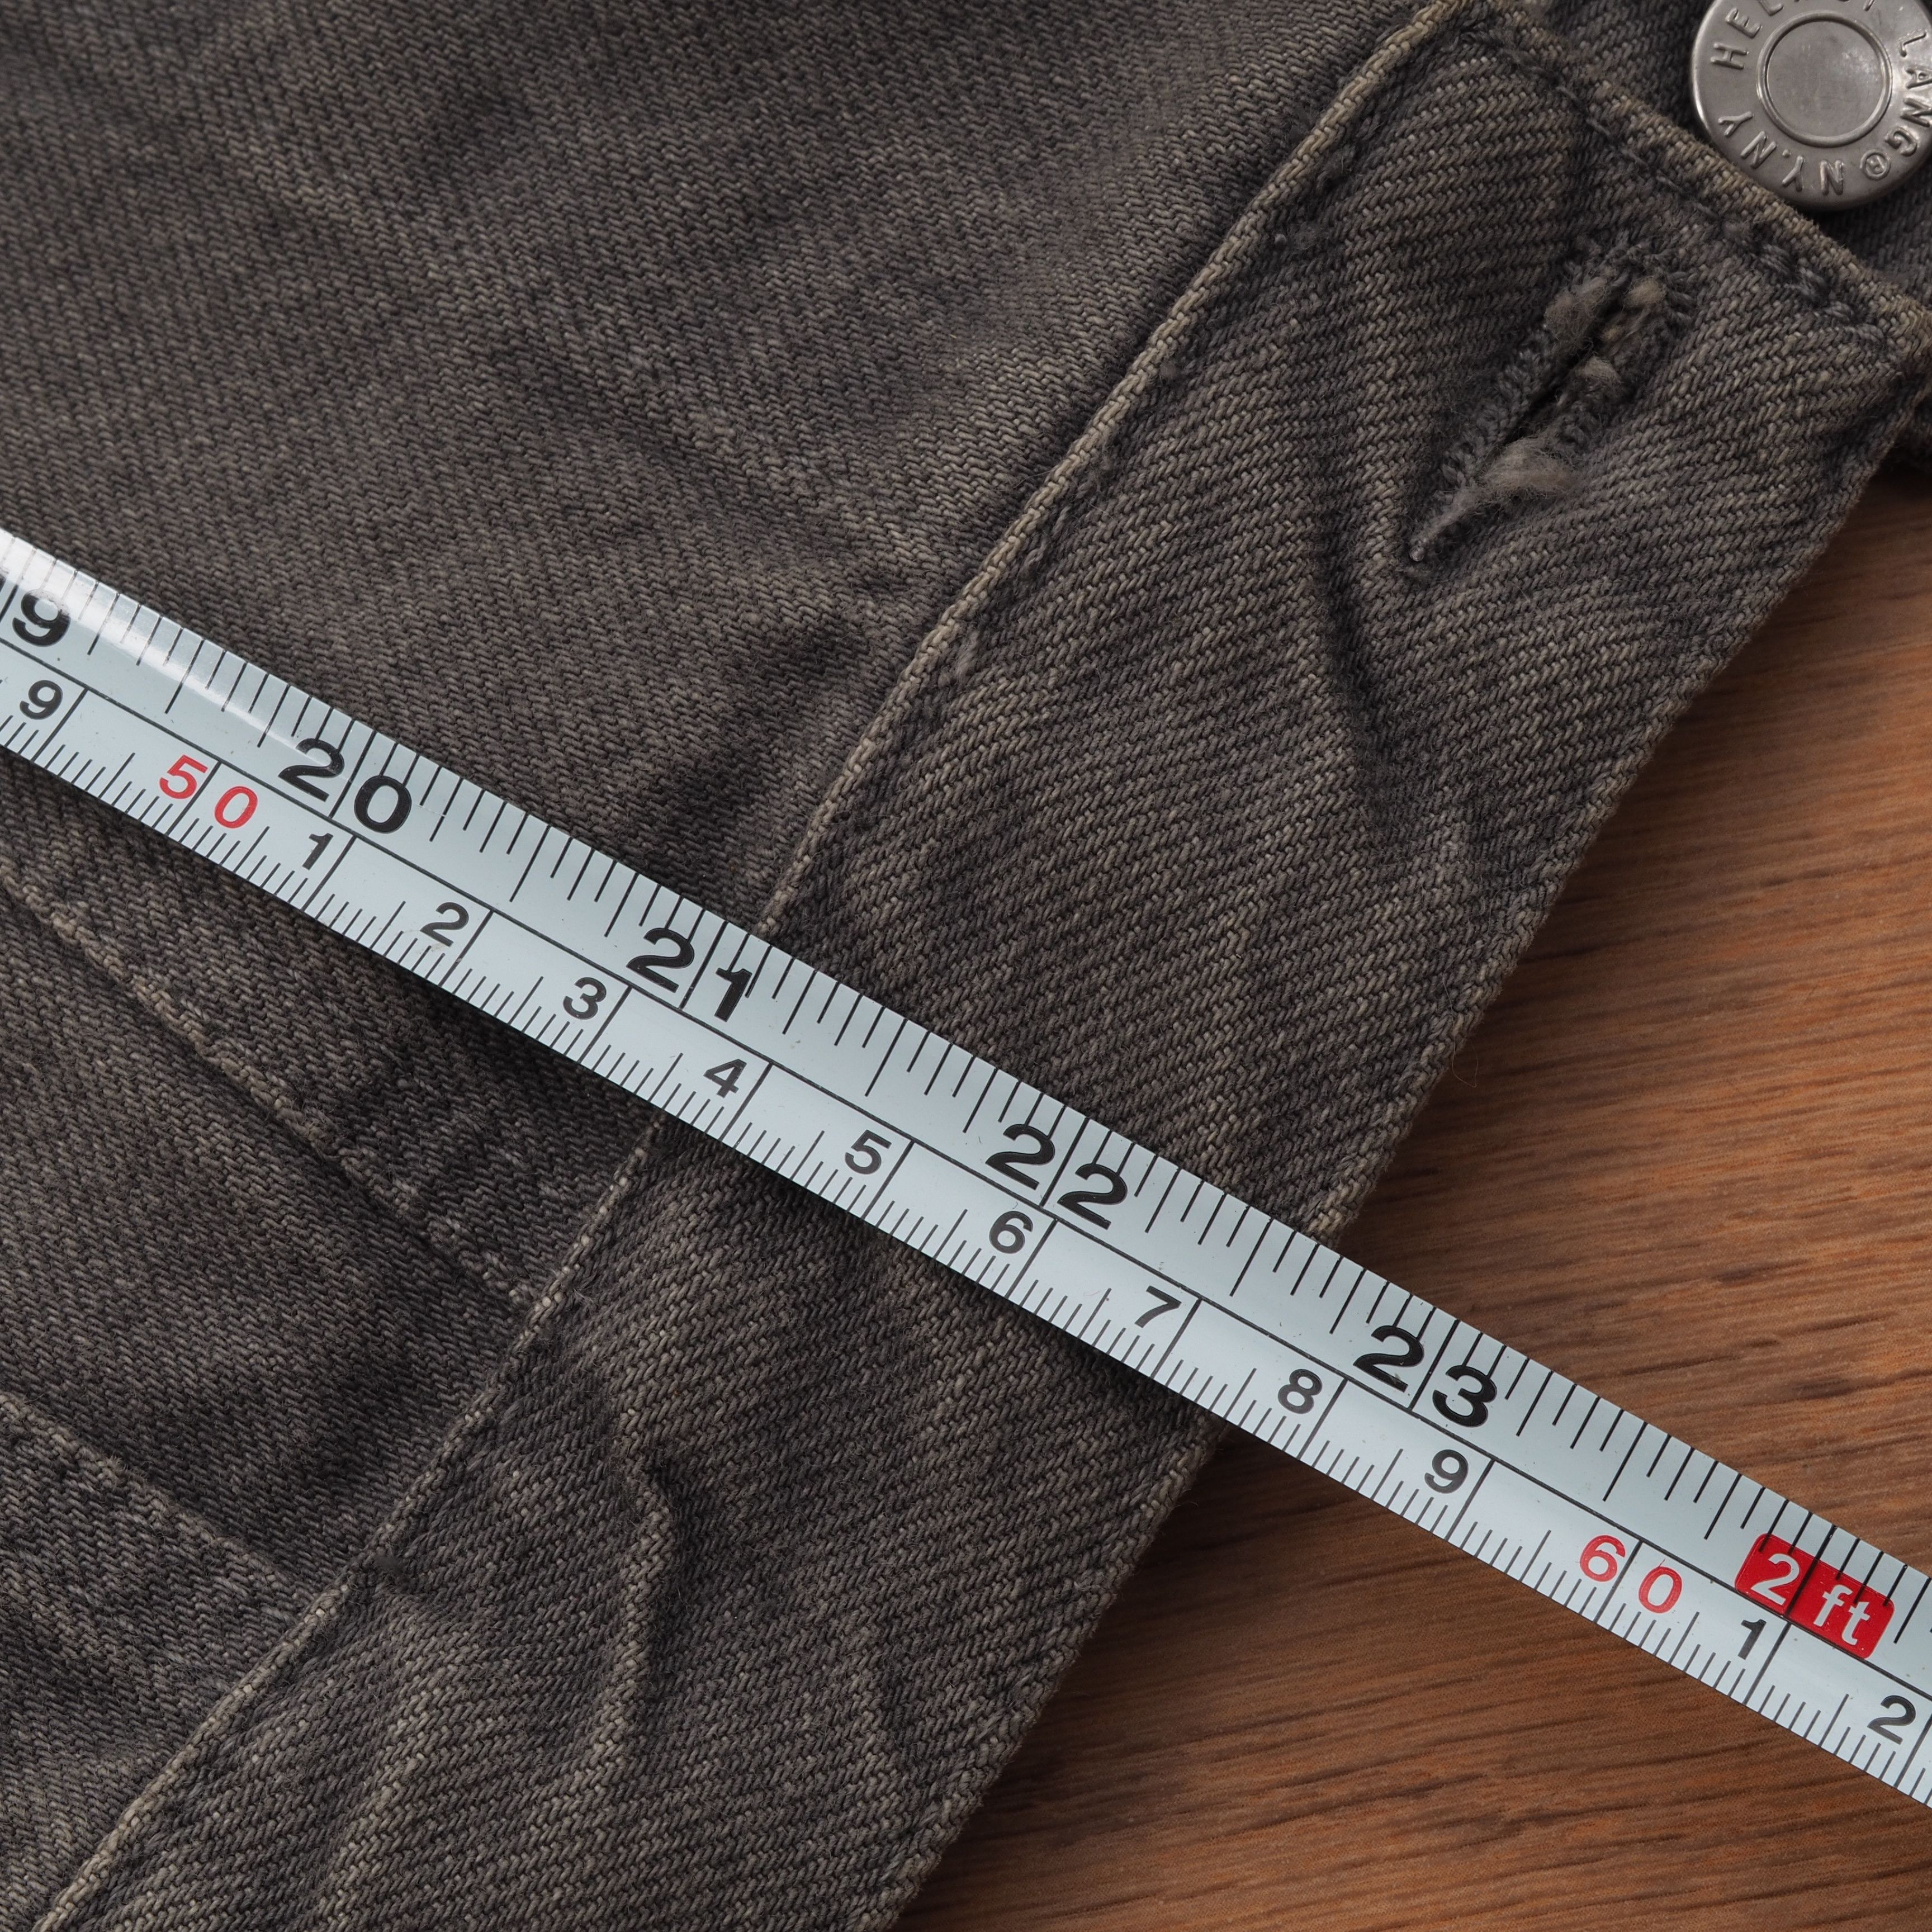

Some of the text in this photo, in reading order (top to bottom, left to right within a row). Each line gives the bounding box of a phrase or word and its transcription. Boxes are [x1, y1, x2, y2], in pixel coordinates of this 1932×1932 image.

[1710, 0, 1874, 70] HEL
[0, 566, 1870, 1646] 9 20 21 22 23 2 ft
[19, 679, 1916, 1745] 9 50 1 2 3 4 5 6 7 8 9 60 1 2
